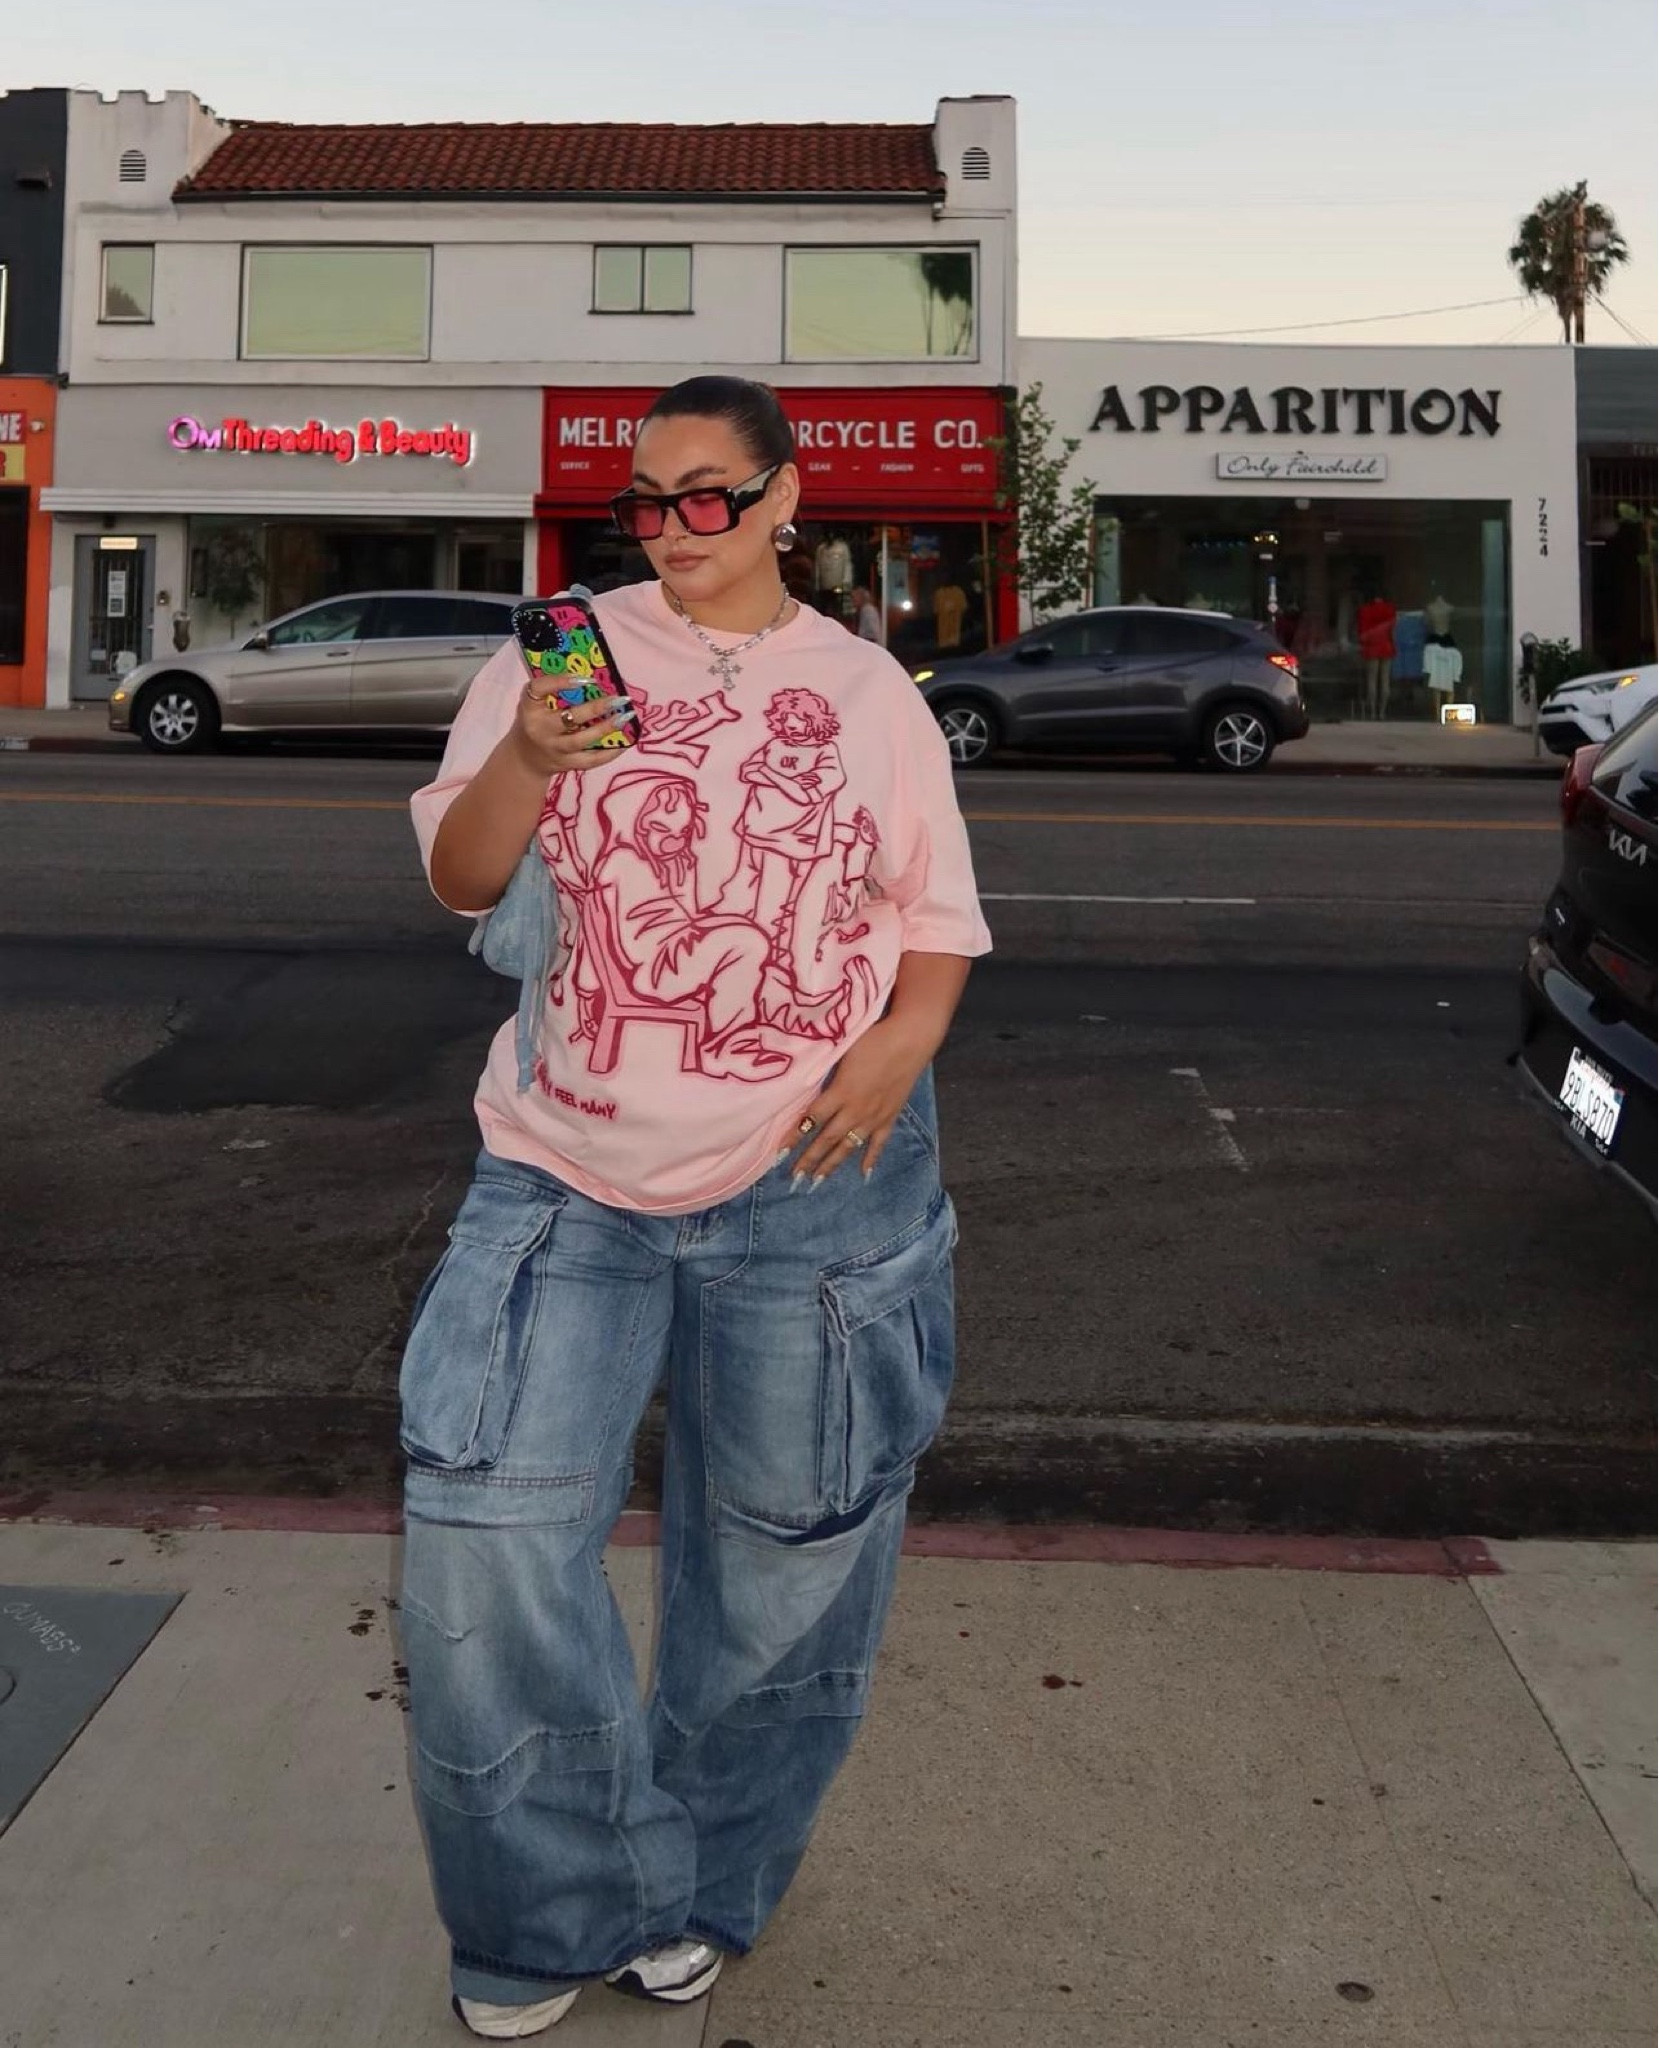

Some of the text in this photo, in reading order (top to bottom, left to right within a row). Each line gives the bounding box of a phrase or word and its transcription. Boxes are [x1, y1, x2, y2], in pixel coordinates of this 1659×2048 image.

[1088, 385, 1502, 437] APPARITION
[222, 418, 355, 463] Threading
[358, 419, 377, 453] &
[379, 419, 472, 466] Beauty
[789, 420, 915, 449] RCYCLE
[933, 419, 985, 449] CO.
[1227, 455, 1377, 478] Only Fairchild
[1608, 829, 1648, 867] KIA
